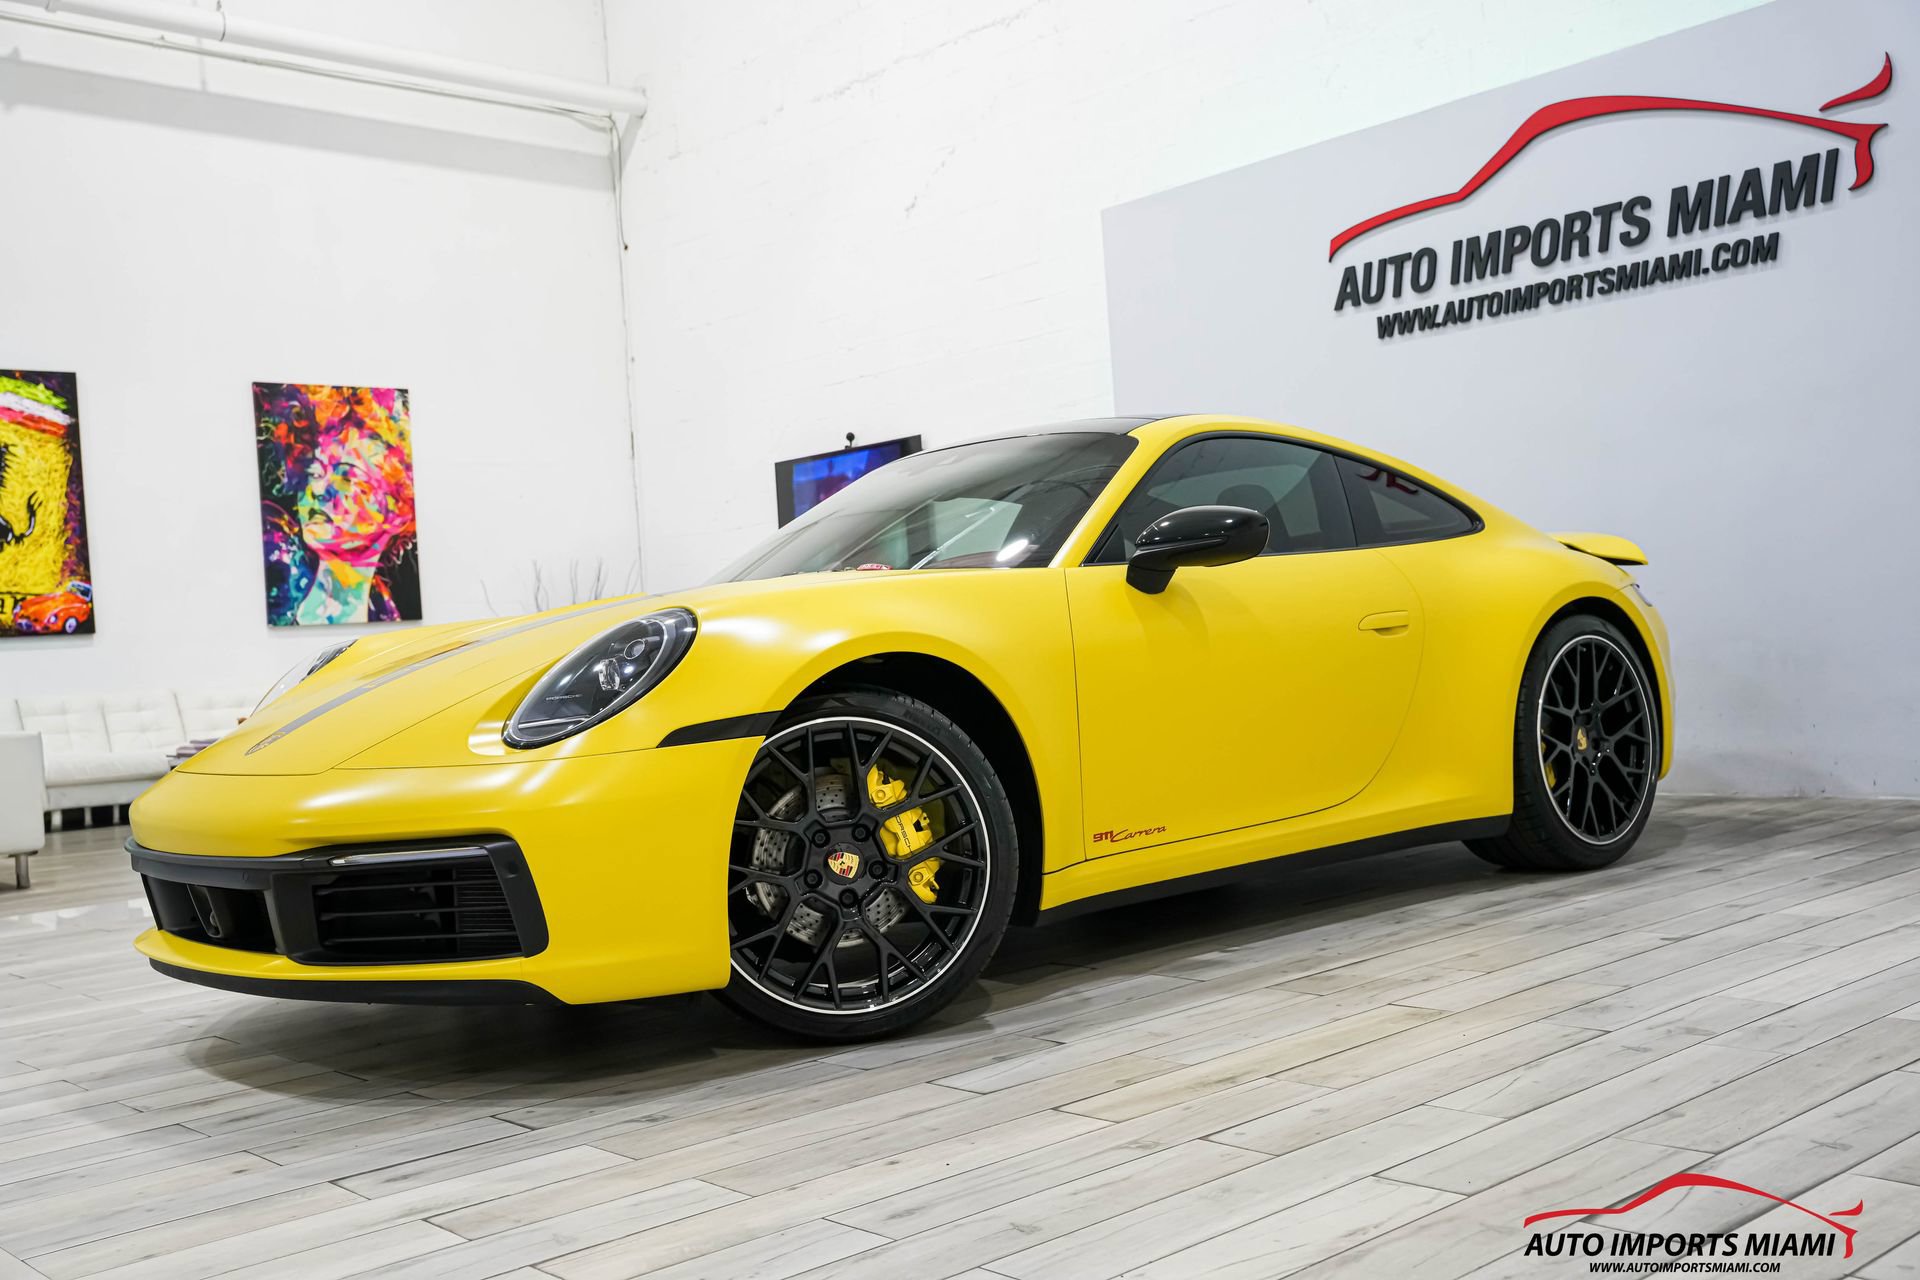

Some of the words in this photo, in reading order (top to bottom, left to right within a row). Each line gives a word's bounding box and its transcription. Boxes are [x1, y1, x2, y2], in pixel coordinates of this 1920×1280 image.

[1334, 247, 1438, 311] AUTO
[1450, 196, 1652, 285] IMPORTS
[1667, 148, 1840, 238] MIAMI
[1377, 232, 1779, 339] WWW.AUTOIMPORTSMIAMI.COM
[1110, 825, 1167, 843] Carrera
